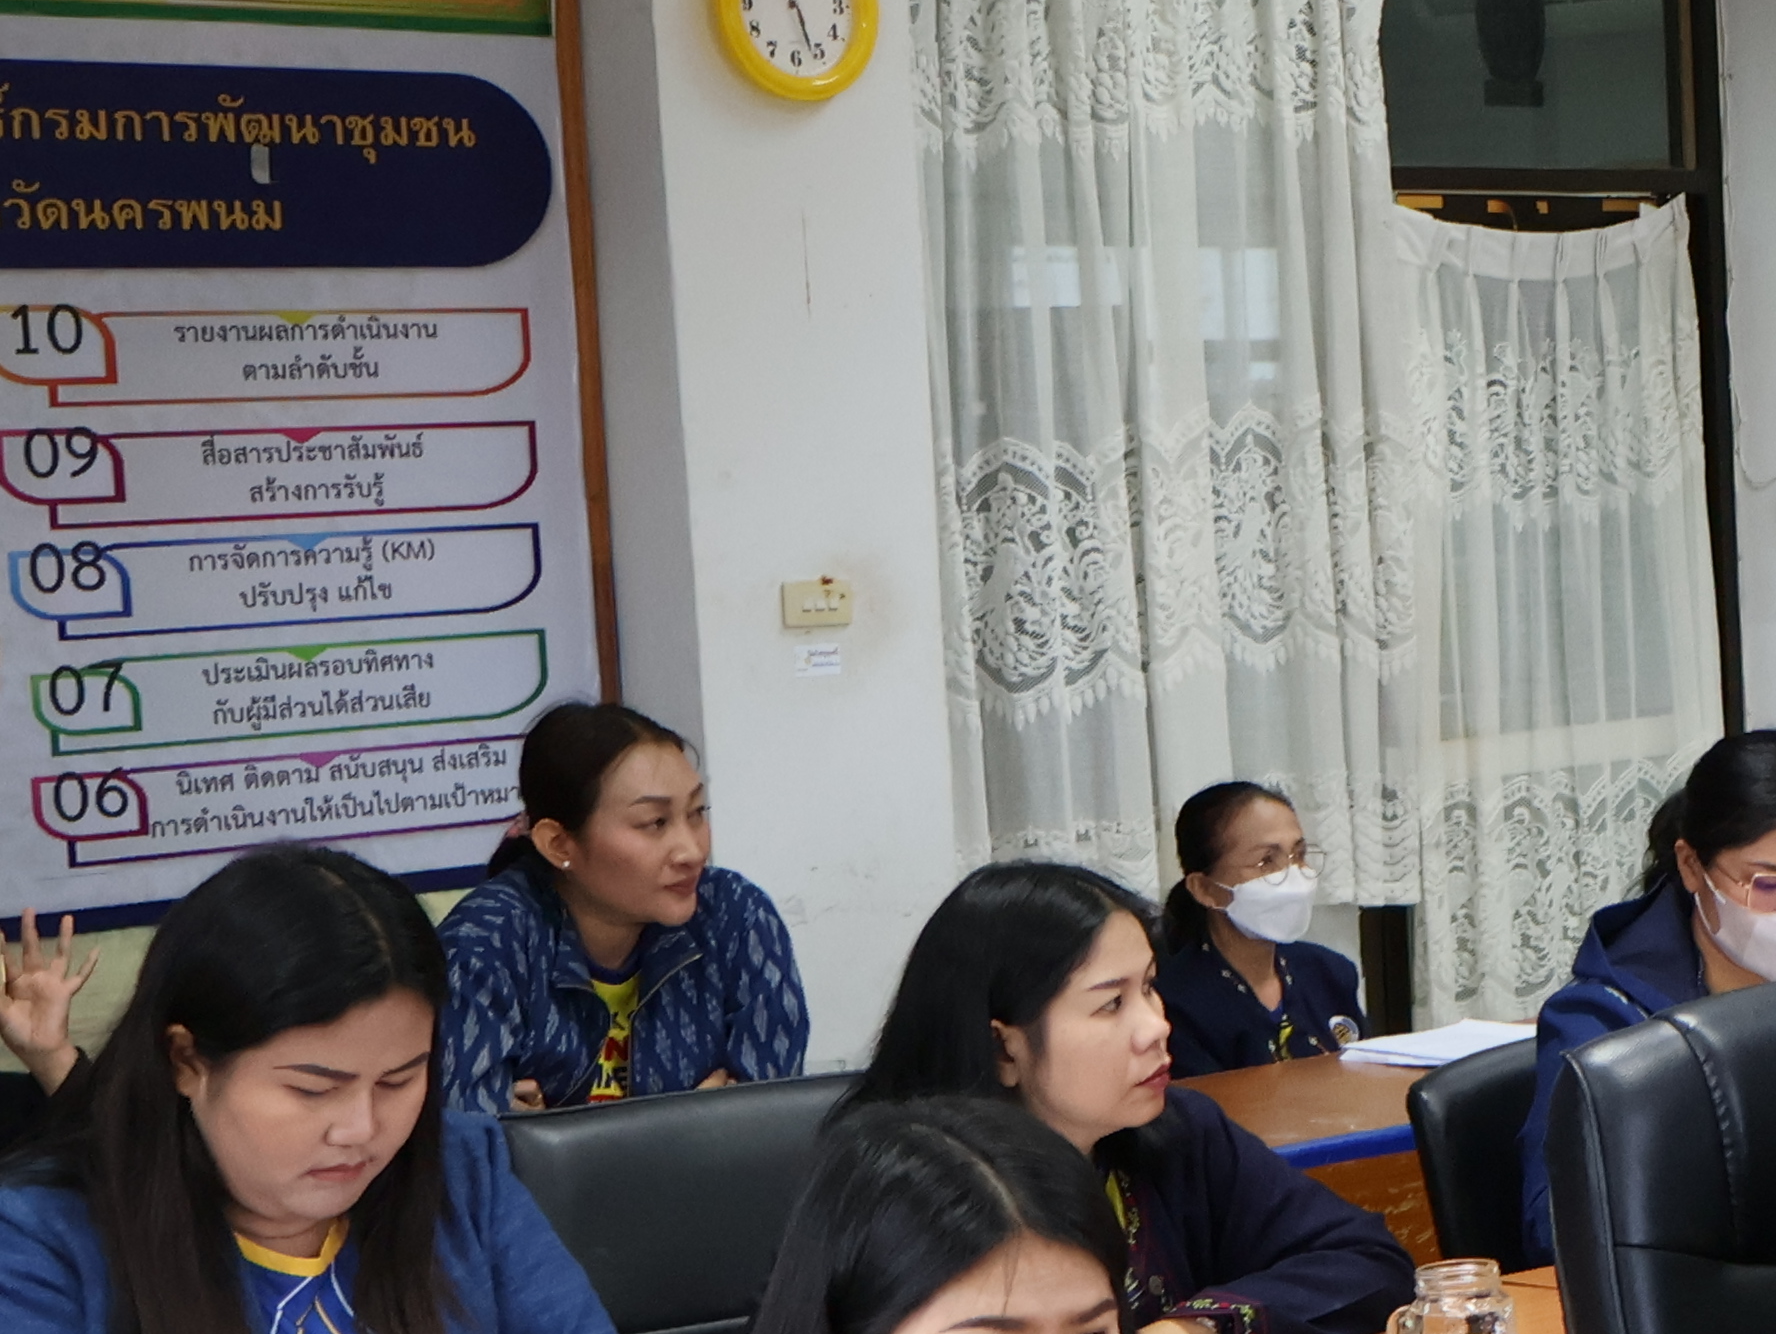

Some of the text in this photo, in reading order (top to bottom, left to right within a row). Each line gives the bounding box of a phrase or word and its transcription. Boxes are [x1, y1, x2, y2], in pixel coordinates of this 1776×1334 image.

[749, 20, 761, 38] 8
[827, 23, 839, 41] 4
[766, 40, 778, 58] 7
[790, 49, 802, 67] 6
[813, 42, 825, 60] 5
[0, 81, 476, 165] กรมการพัฒนาชุมชน
[2, 178, 283, 231] วัดนครพนม
[12, 302, 84, 356] 10
[173, 315, 438, 347] รายงานผลการดำเนินงาน
[242, 345, 379, 382] ตามลำดับชั้น
[24, 426, 99, 479] 09
[200, 433, 425, 467] สื่อสารประชาสัมพันธ์
[249, 473, 387, 508] สร้างการรับรู้
[29, 540, 107, 594] 08
[188, 537, 436, 574] การจัดการความรู้ (KM)
[239, 573, 393, 613] ปรับปรุง แก้ไข
[202, 649, 435, 688] ประเมินผลรอบทิศทาง
[49, 661, 123, 716] 07
[212, 688, 432, 733] กับผู้มีส่วนได้ส่วนเสีย
[175, 742, 507, 798] นิเทศ ติดตาม สนับสนุน ส่งเสริม
[53, 767, 129, 822] 06
[151, 779, 520, 842] การดำเนินงานให้เป็นไปตามเป้าหมา
